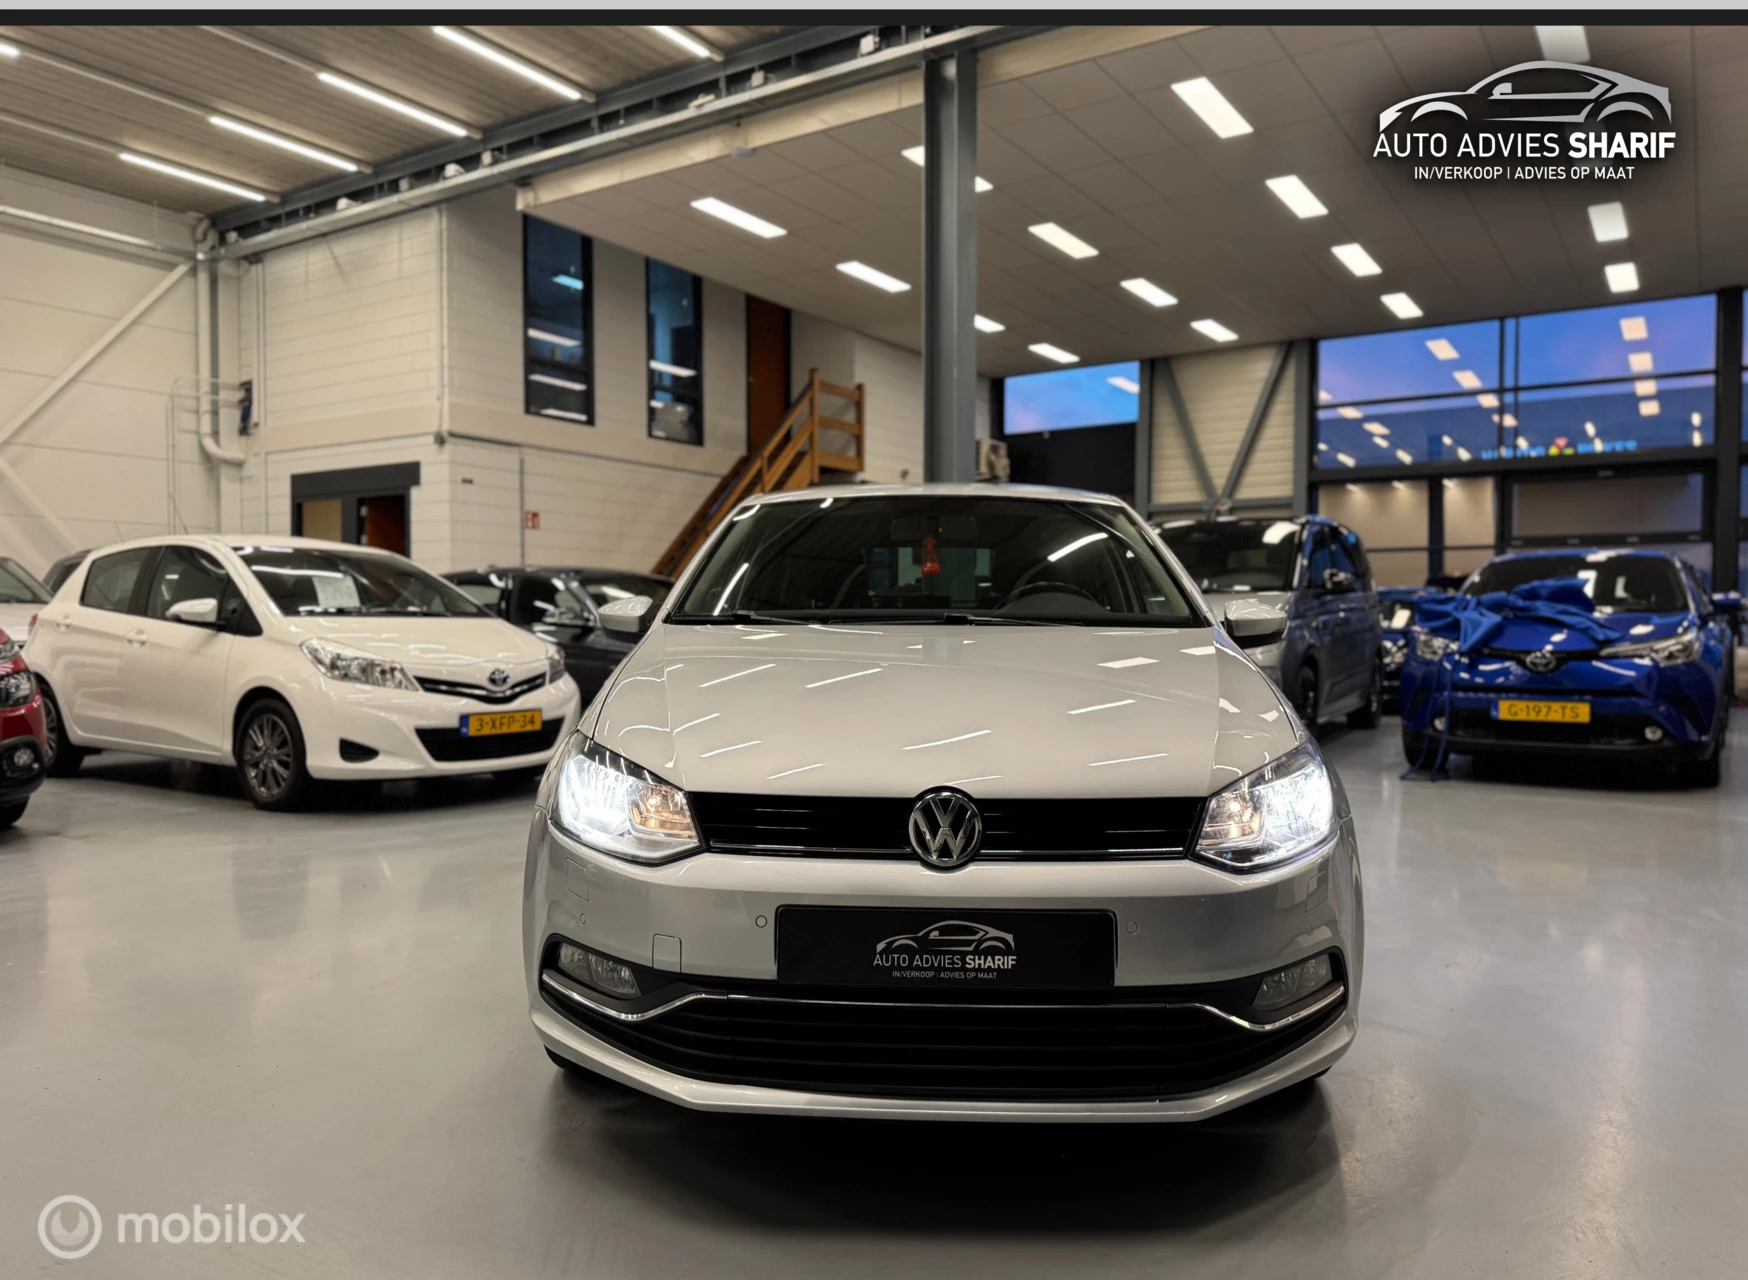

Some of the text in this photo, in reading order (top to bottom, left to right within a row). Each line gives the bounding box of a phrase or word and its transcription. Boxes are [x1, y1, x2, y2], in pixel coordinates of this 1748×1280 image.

[1507, 703, 1581, 720] G-197-TS
[475, 714, 536, 732] 3-XFP-34
[873, 954, 1017, 969] AUTO ADVIES SHARIF
[892, 970, 935, 979] IN/VERKOOP
[939, 971, 965, 979] ADVIES
[966, 971, 977, 979] OP
[978, 972, 997, 980] MAAT
